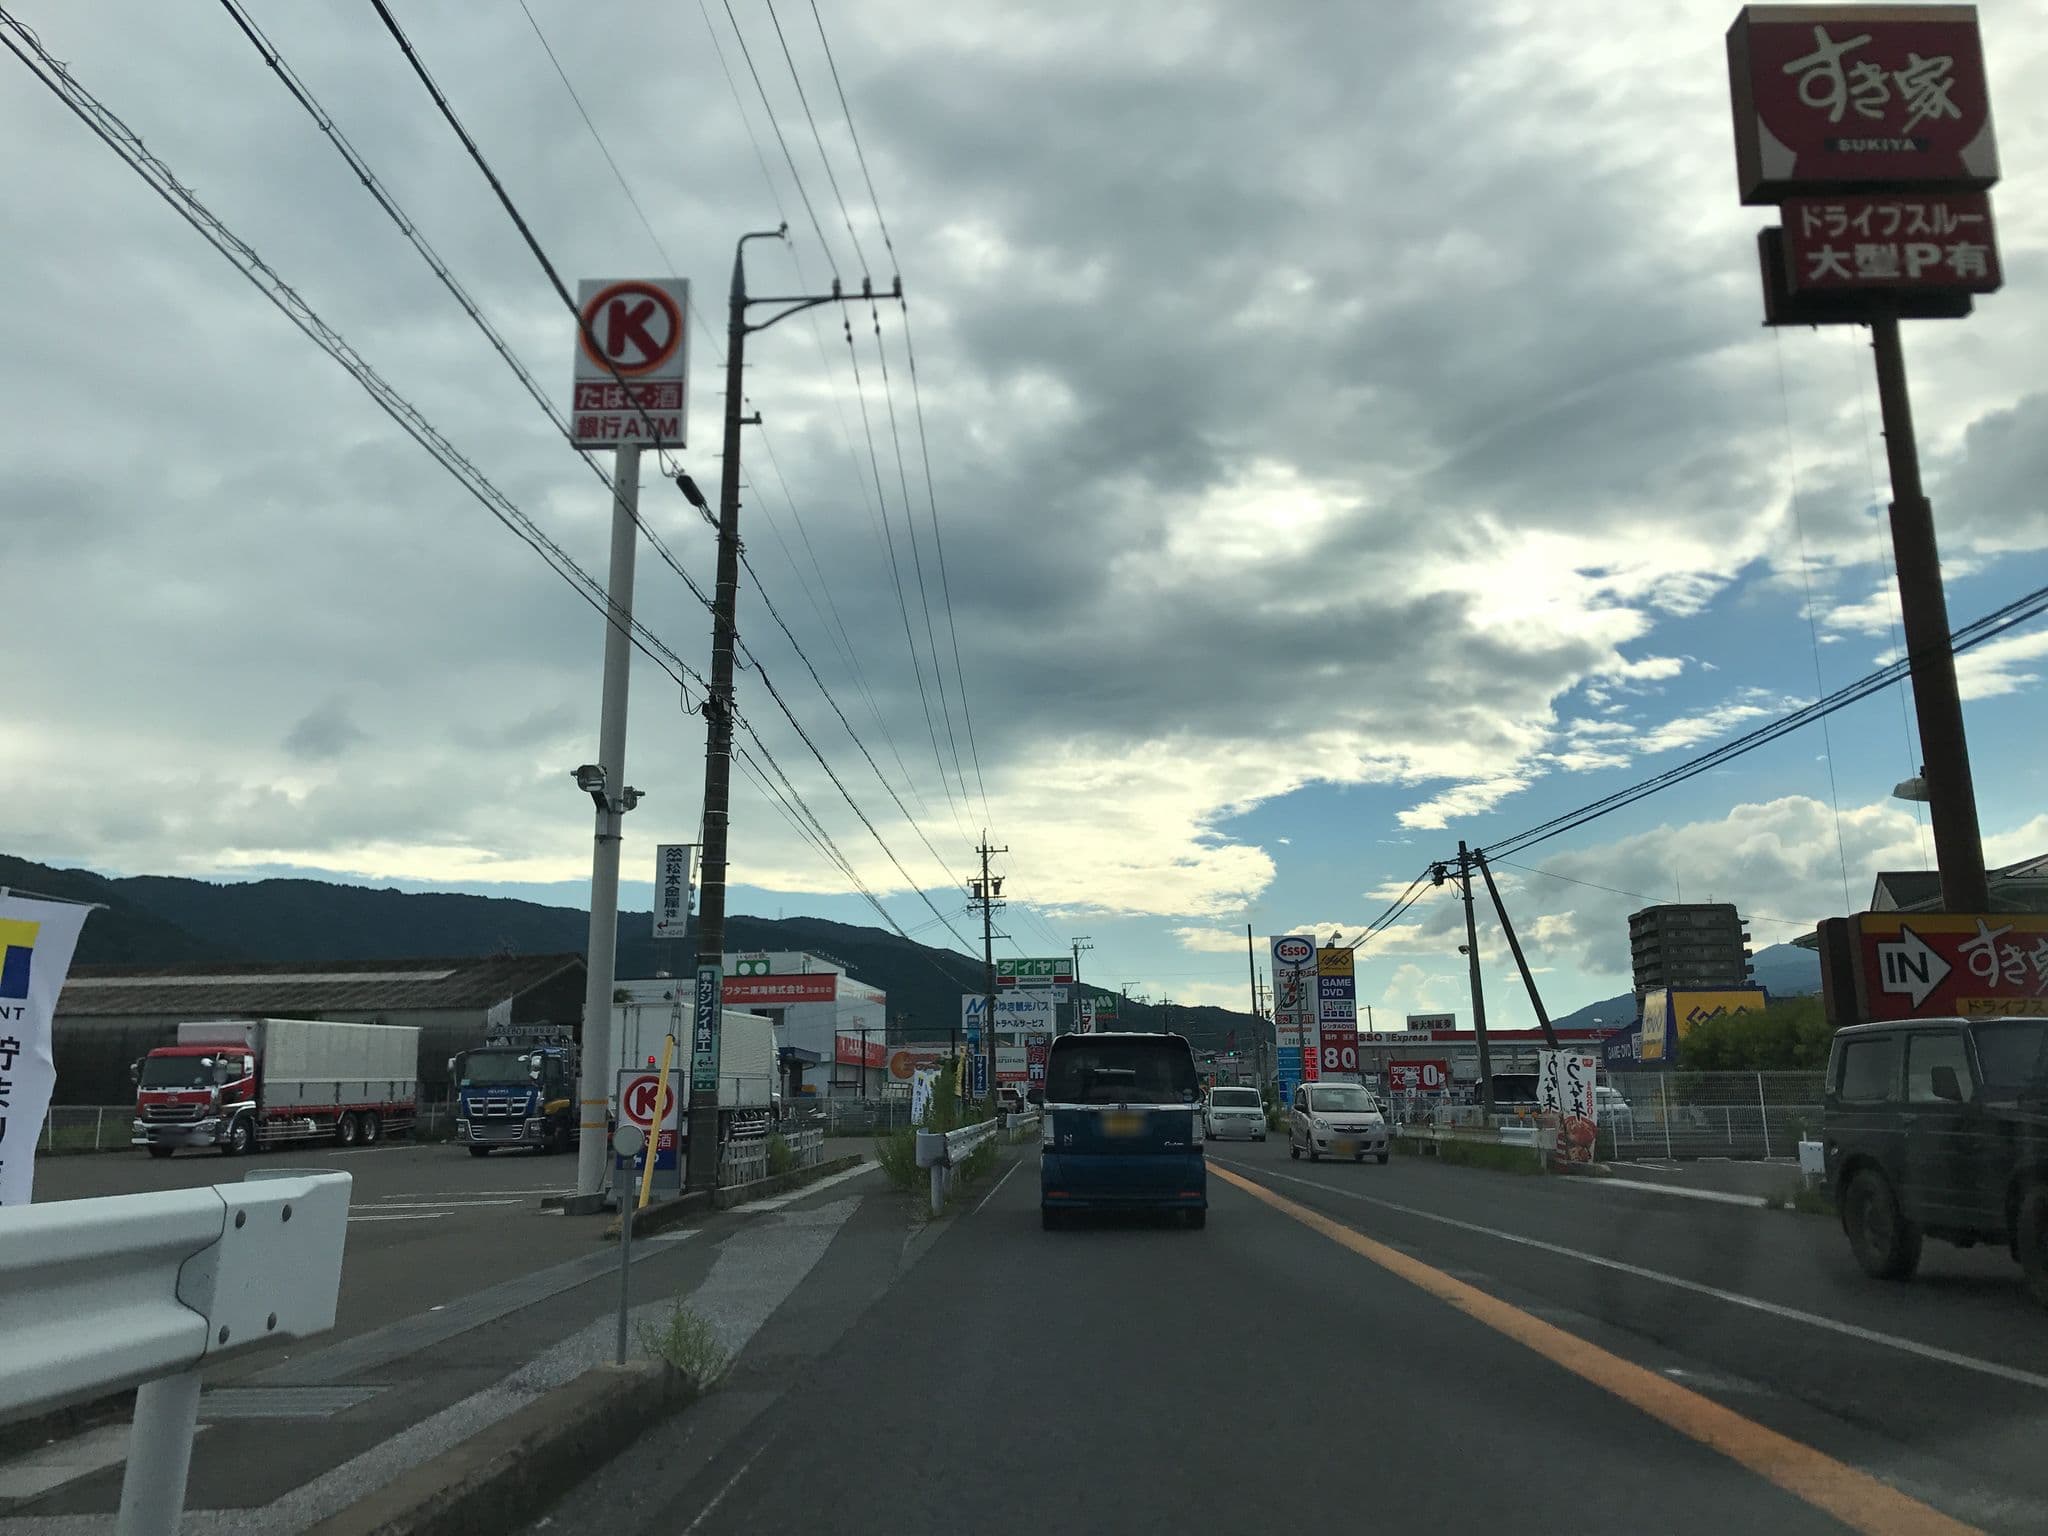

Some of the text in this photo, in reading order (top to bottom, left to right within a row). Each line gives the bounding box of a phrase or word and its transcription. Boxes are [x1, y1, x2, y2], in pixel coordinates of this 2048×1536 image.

[1783, 25, 1962, 134] すき家
[1838, 138, 1918, 151] SUKIYA
[1800, 204, 1984, 238] ドライブスルー
[1807, 242, 1989, 280] 大型P有
[1281, 945, 1308, 956] Esso
[1000, 961, 1072, 974] タイヤ館
[1886, 952, 1930, 983] IN
[1322, 978, 1351, 987] GAME
[1322, 988, 1344, 997] DVD
[1391, 1034, 1429, 1042] Express
[1567, 1057, 1587, 1121] うな牛
